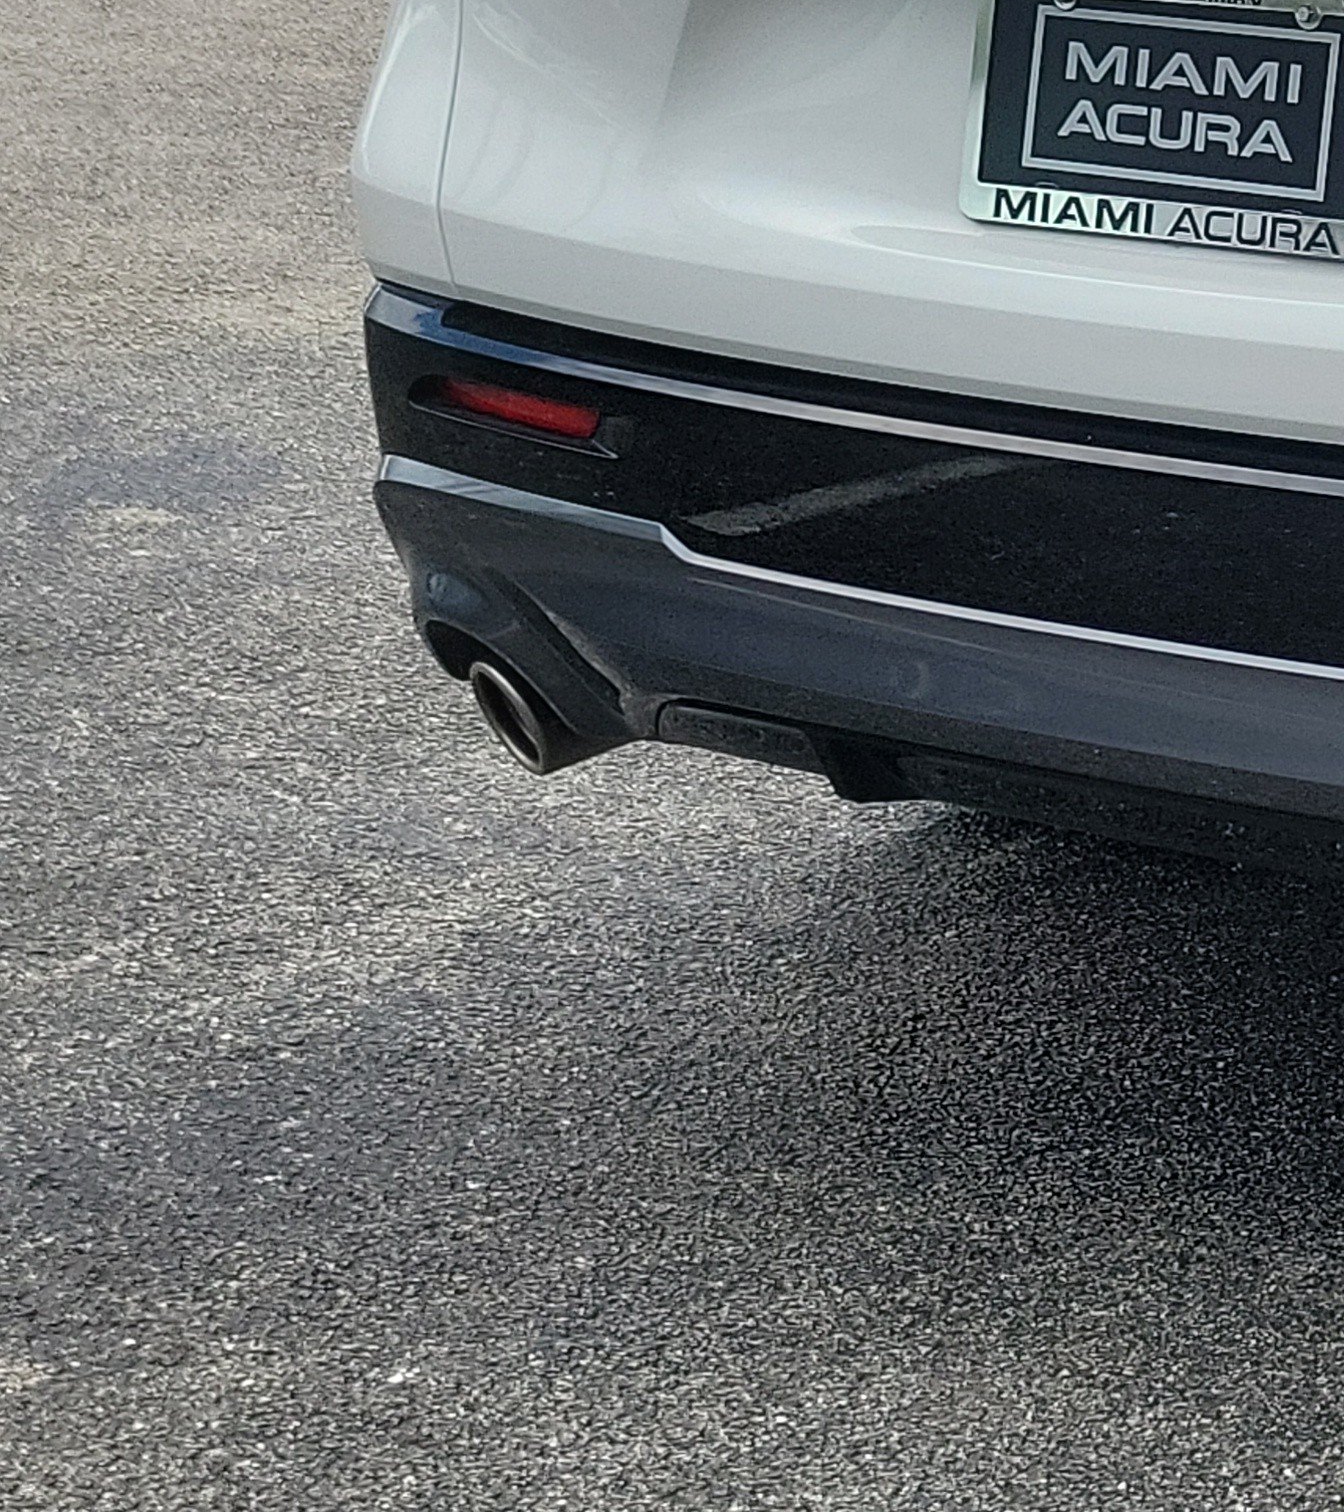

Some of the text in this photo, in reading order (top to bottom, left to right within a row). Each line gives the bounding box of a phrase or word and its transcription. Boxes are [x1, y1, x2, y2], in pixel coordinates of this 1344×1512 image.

[1064, 41, 1303, 104] MIAMI
[1056, 99, 1293, 163] ACURA
[993, 188, 1341, 256] MIAMI ACURA
